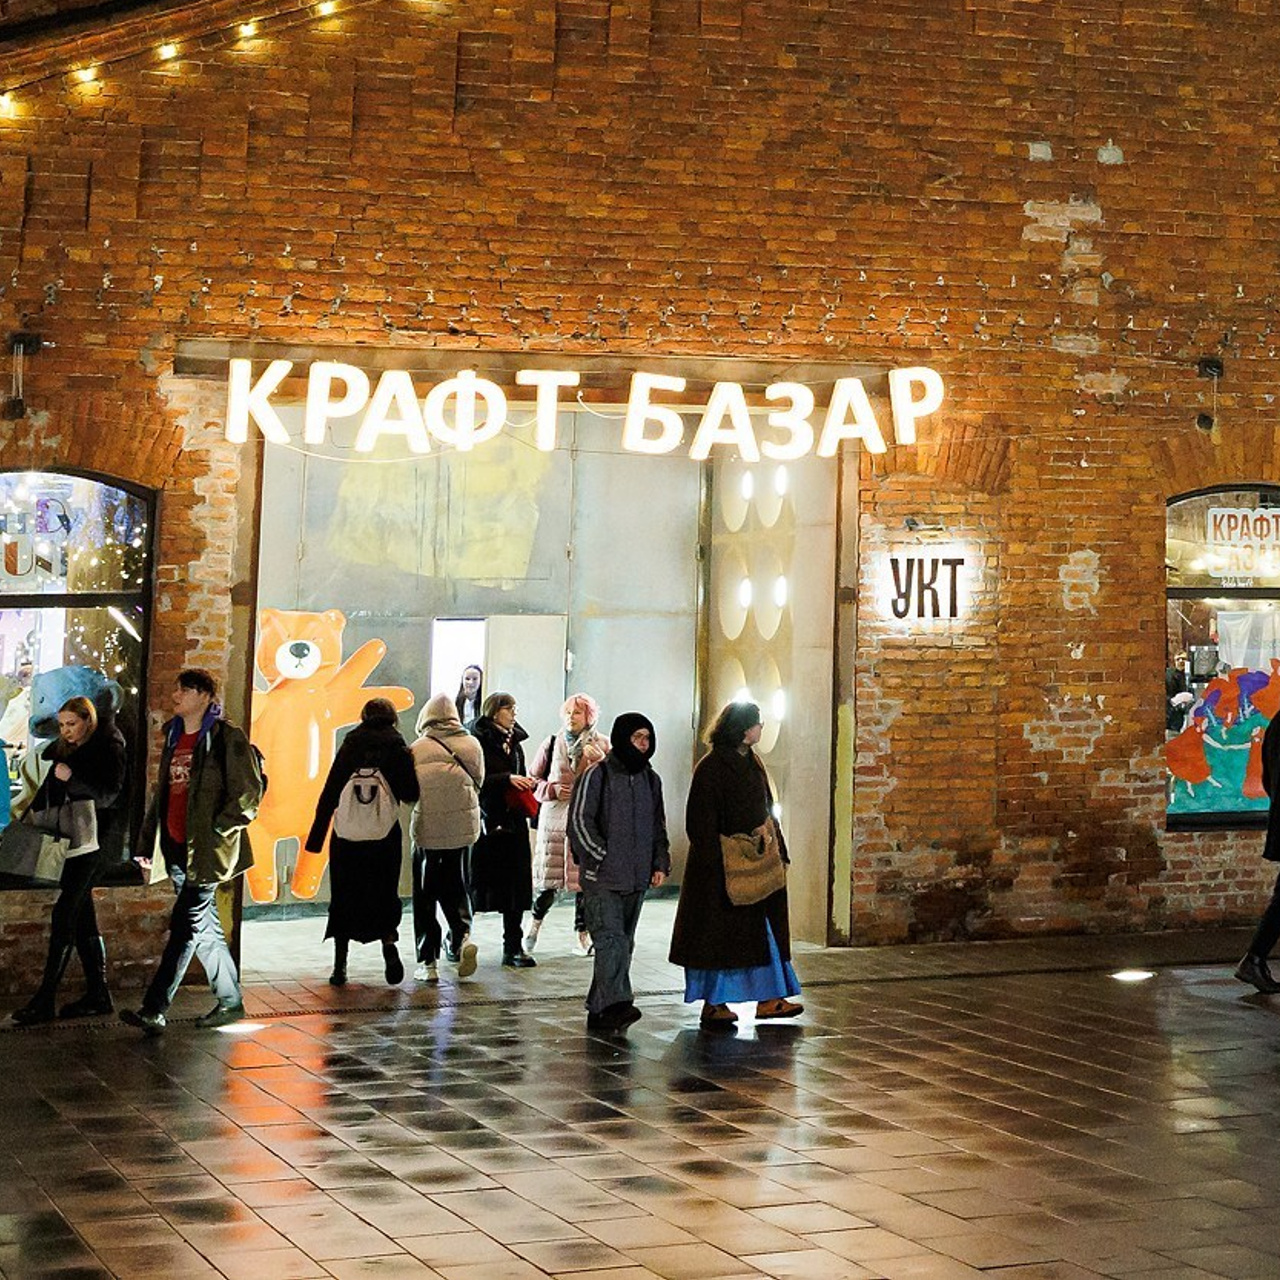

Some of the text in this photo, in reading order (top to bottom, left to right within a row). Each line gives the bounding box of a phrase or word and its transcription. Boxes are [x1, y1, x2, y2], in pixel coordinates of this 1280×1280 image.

[225, 358, 945, 462] КРАФТ БАЗАР
[890, 558, 965, 618] УКТ
